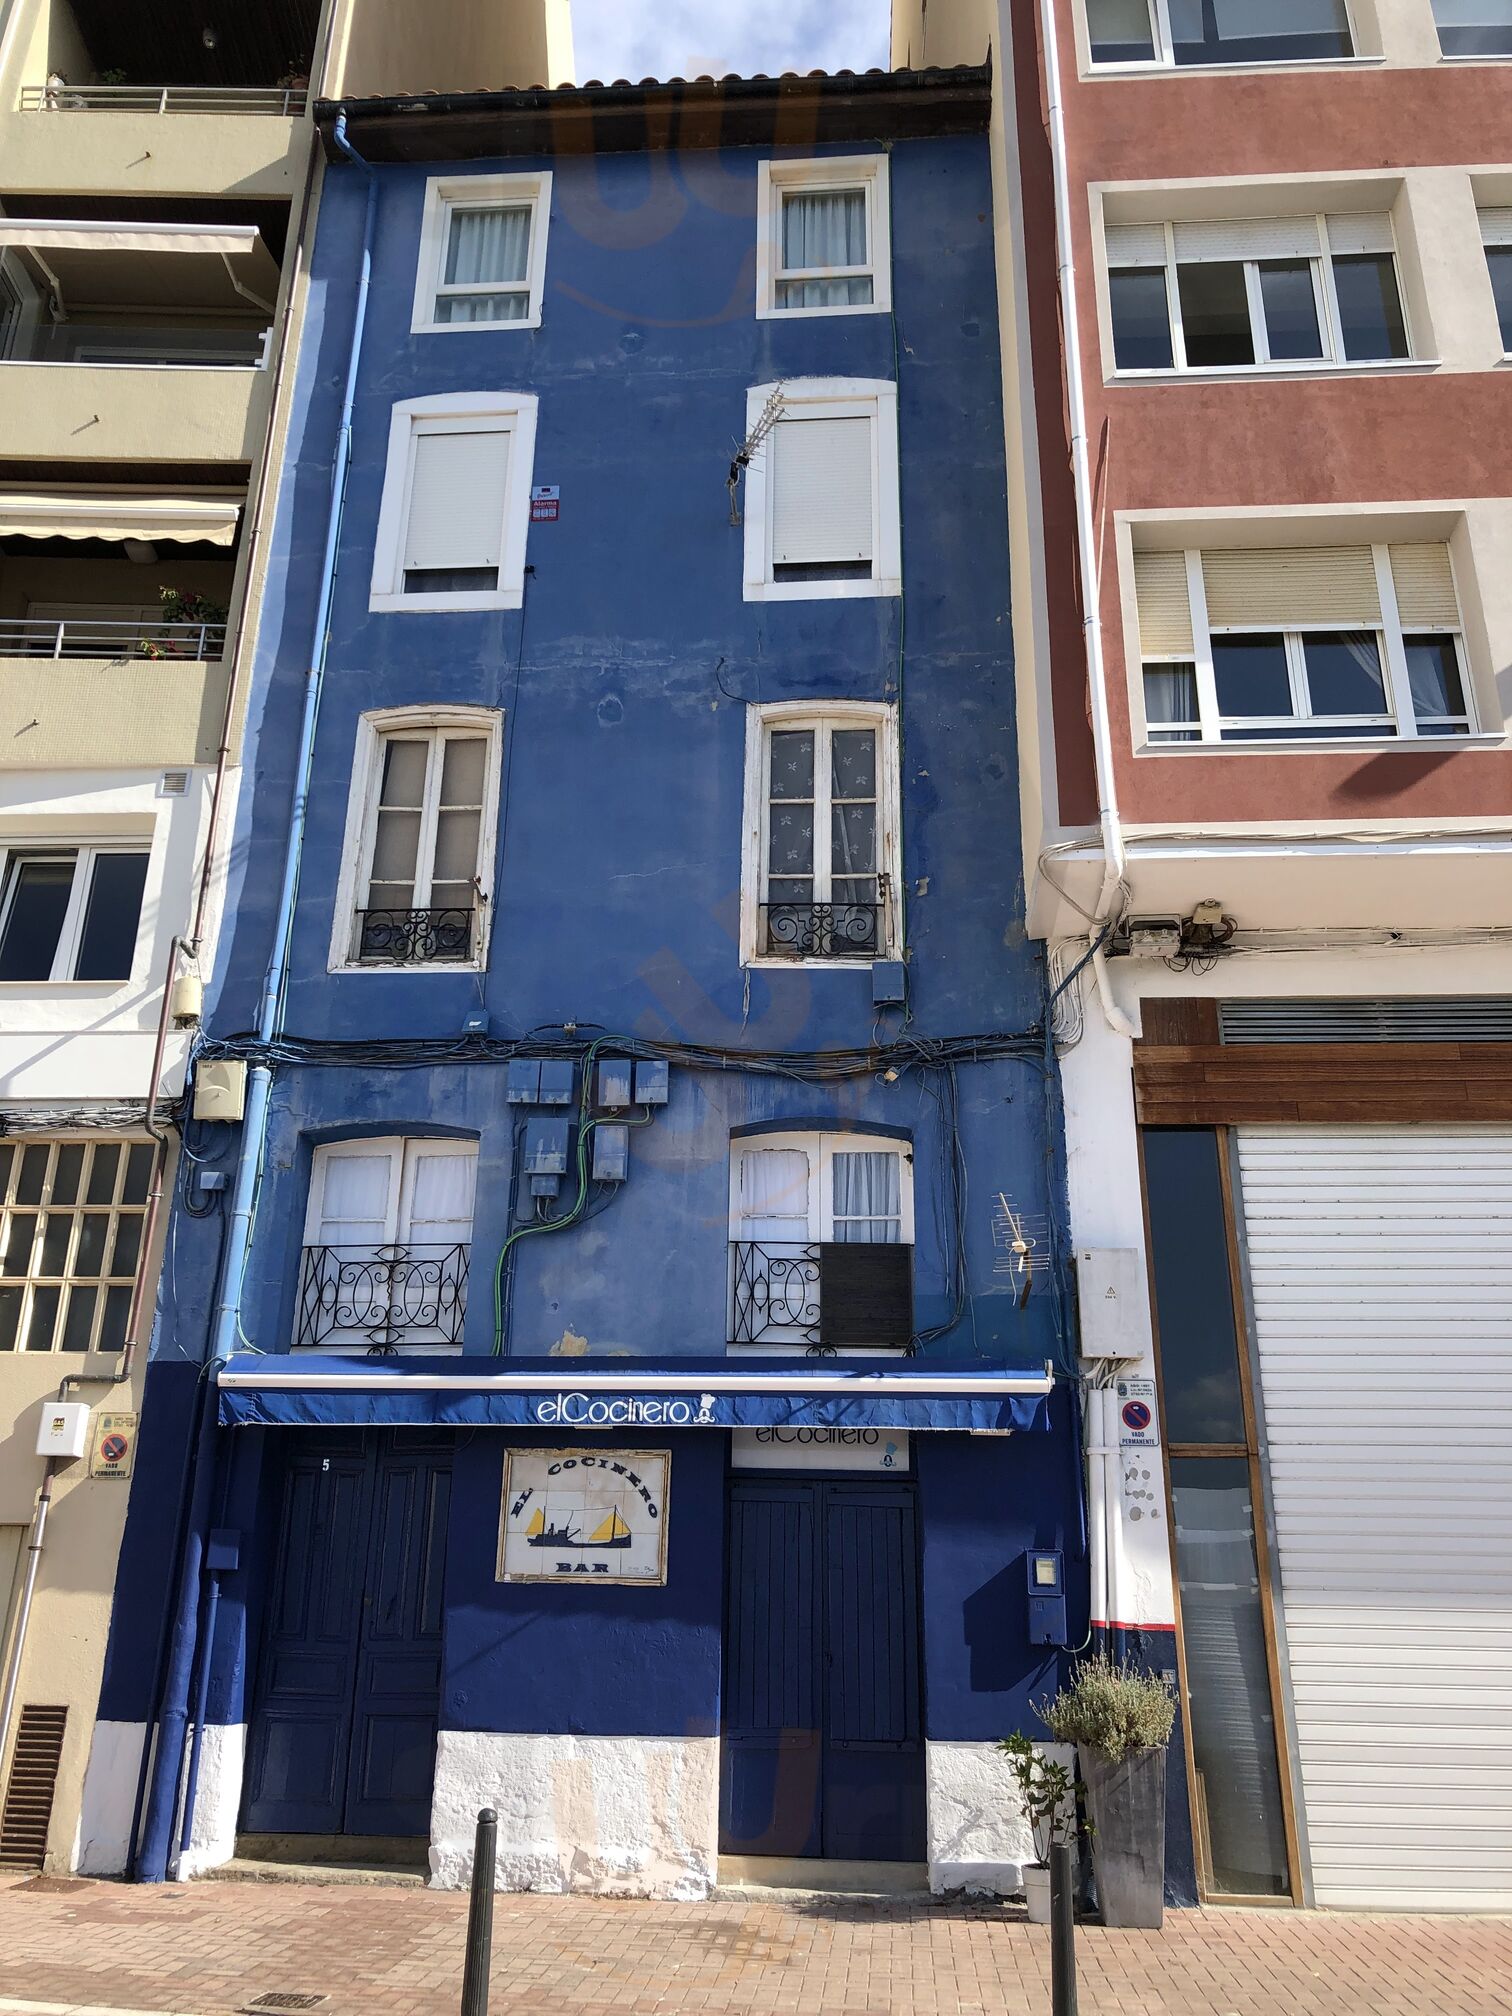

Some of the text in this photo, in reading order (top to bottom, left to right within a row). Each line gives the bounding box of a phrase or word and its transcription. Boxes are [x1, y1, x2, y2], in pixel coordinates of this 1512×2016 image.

[322, 1458, 330, 1471] 5
[510, 1457, 658, 1519] EL COCINERO
[555, 1562, 609, 1573] BAR
